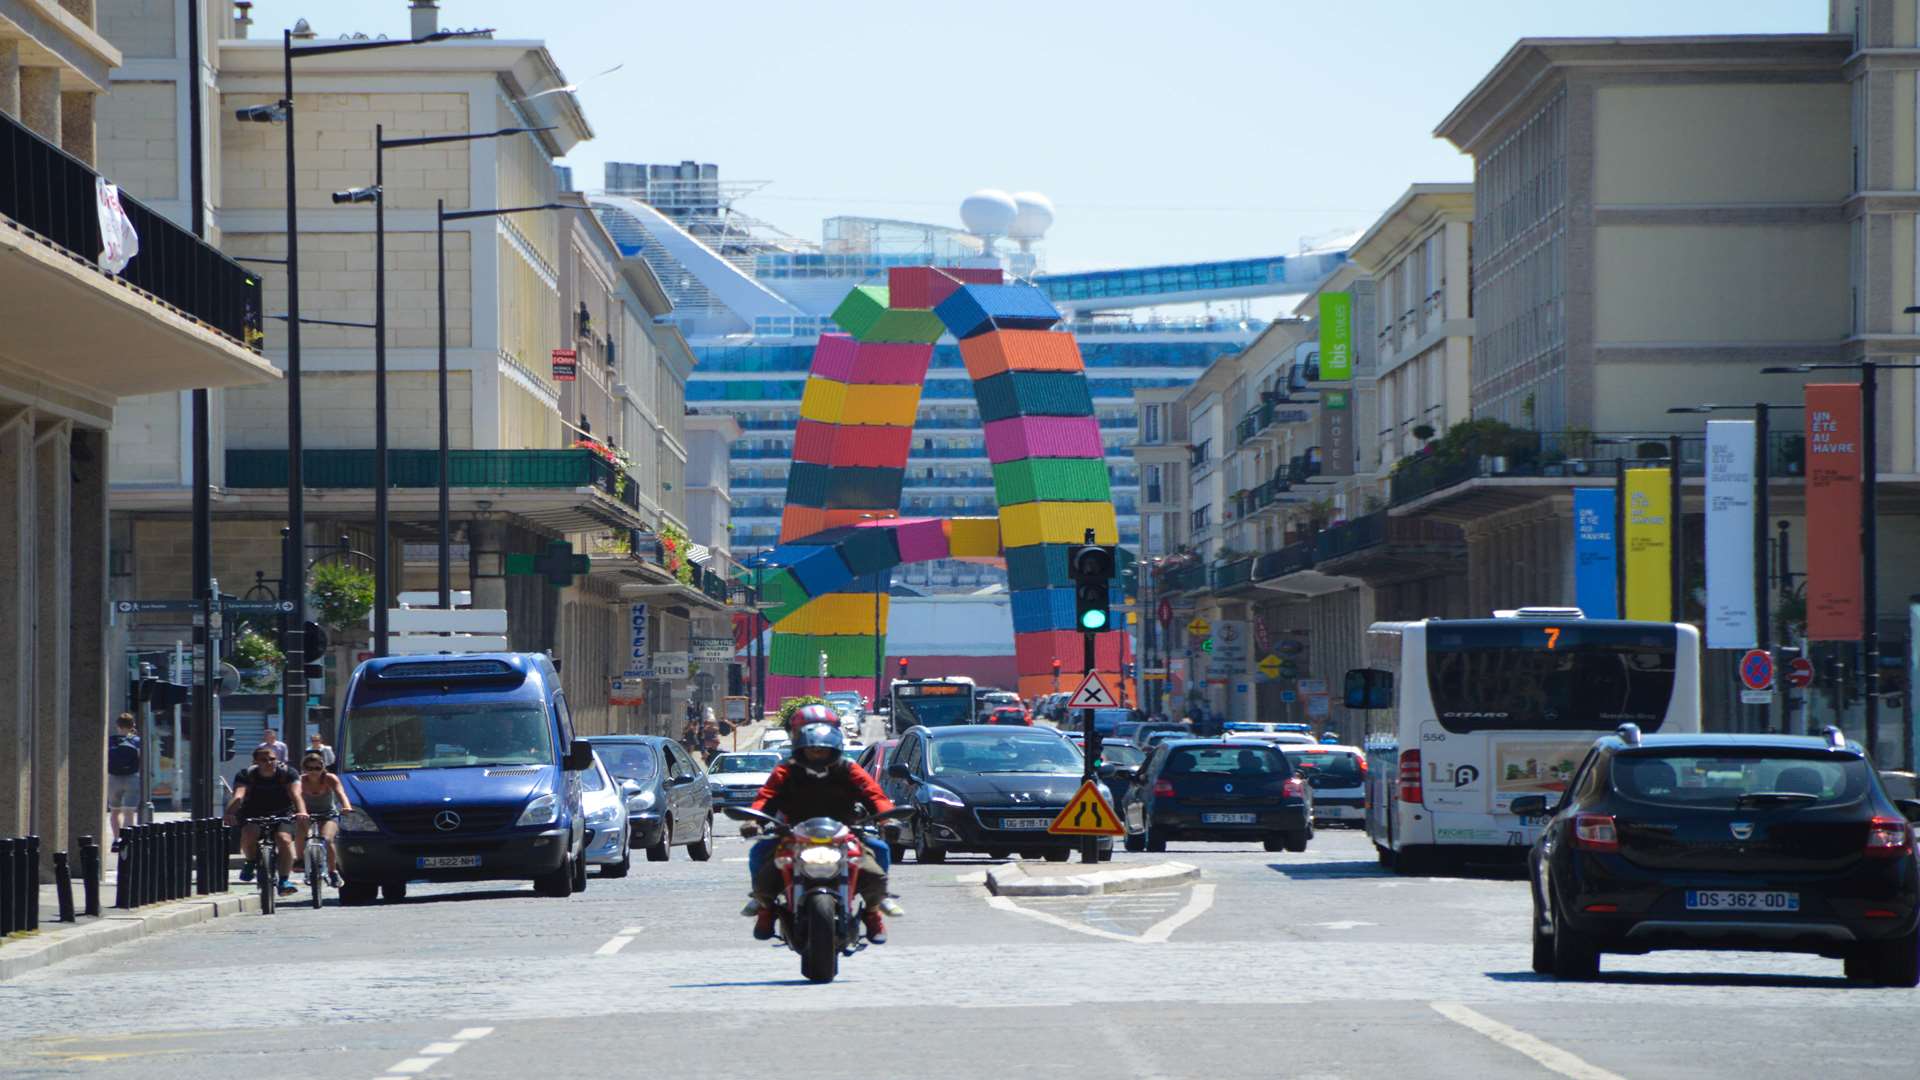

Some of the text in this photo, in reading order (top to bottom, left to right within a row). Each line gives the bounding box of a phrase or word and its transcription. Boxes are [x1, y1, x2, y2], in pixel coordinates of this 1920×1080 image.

[1329, 343, 1347, 369] ibis
[1813, 411, 1830, 421] UN
[1812, 420, 1838, 432] ÉTÉ
[1331, 415, 1342, 470] HOTEL
[1813, 433, 1830, 442] AU
[1813, 443, 1855, 453] HAVRE
[632, 604, 645, 658] HOTEL
[1544, 627, 1560, 649] 7
[1423, 733, 1446, 742] 556
